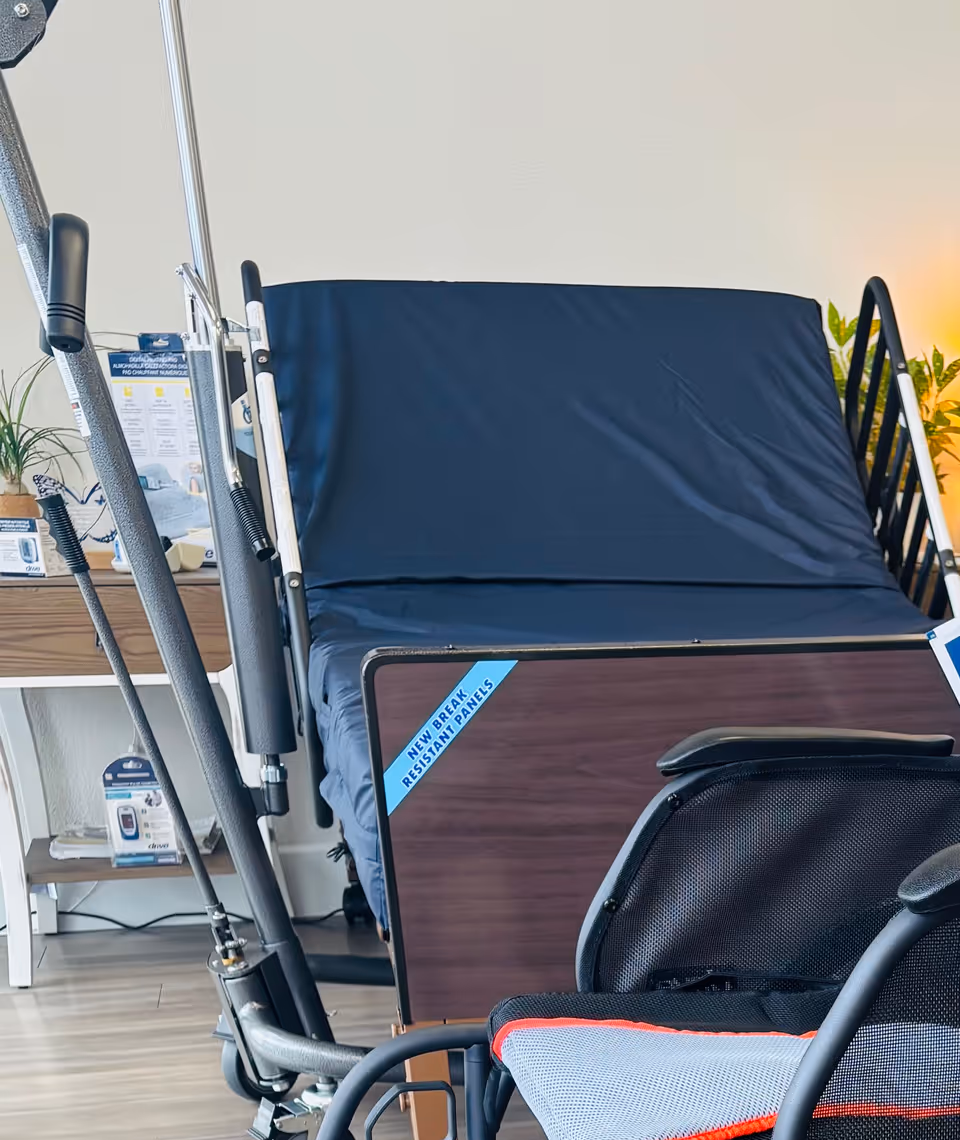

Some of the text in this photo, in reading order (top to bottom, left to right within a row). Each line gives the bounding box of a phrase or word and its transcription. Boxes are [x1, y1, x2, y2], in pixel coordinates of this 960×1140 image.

[401, 678, 493, 788] RESISTANT PANELS
[407, 688, 468, 760] NEW BREAK
